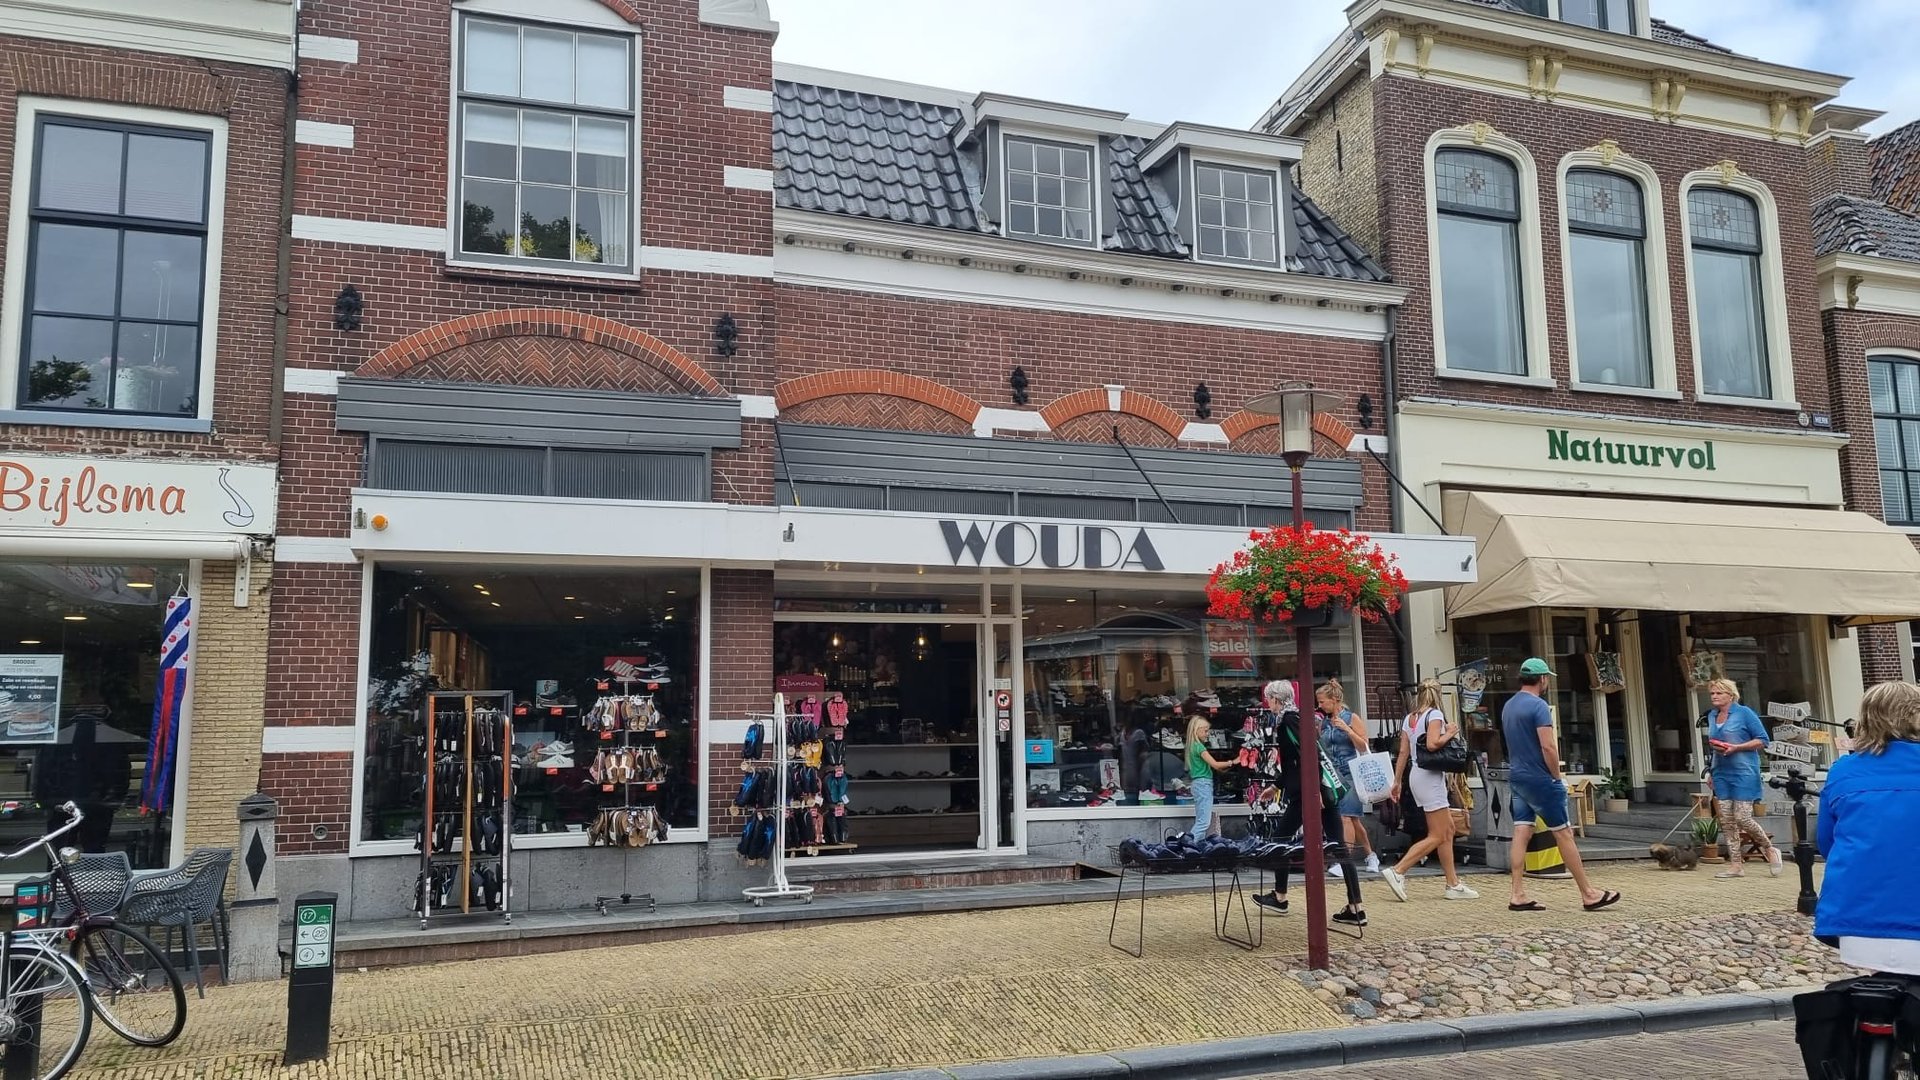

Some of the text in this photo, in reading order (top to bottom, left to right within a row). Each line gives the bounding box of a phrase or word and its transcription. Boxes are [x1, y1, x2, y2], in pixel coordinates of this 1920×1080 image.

[1546, 429, 1716, 470] Natuurvol
[0, 461, 186, 526] Bijlsma
[938, 520, 1165, 571] WOUDA
[1209, 638, 1249, 652] sale!
[1775, 742, 1803, 757] ETEN
[303, 911, 314, 920] 17
[314, 929, 326, 938] 22
[303, 951, 310, 959] 4
